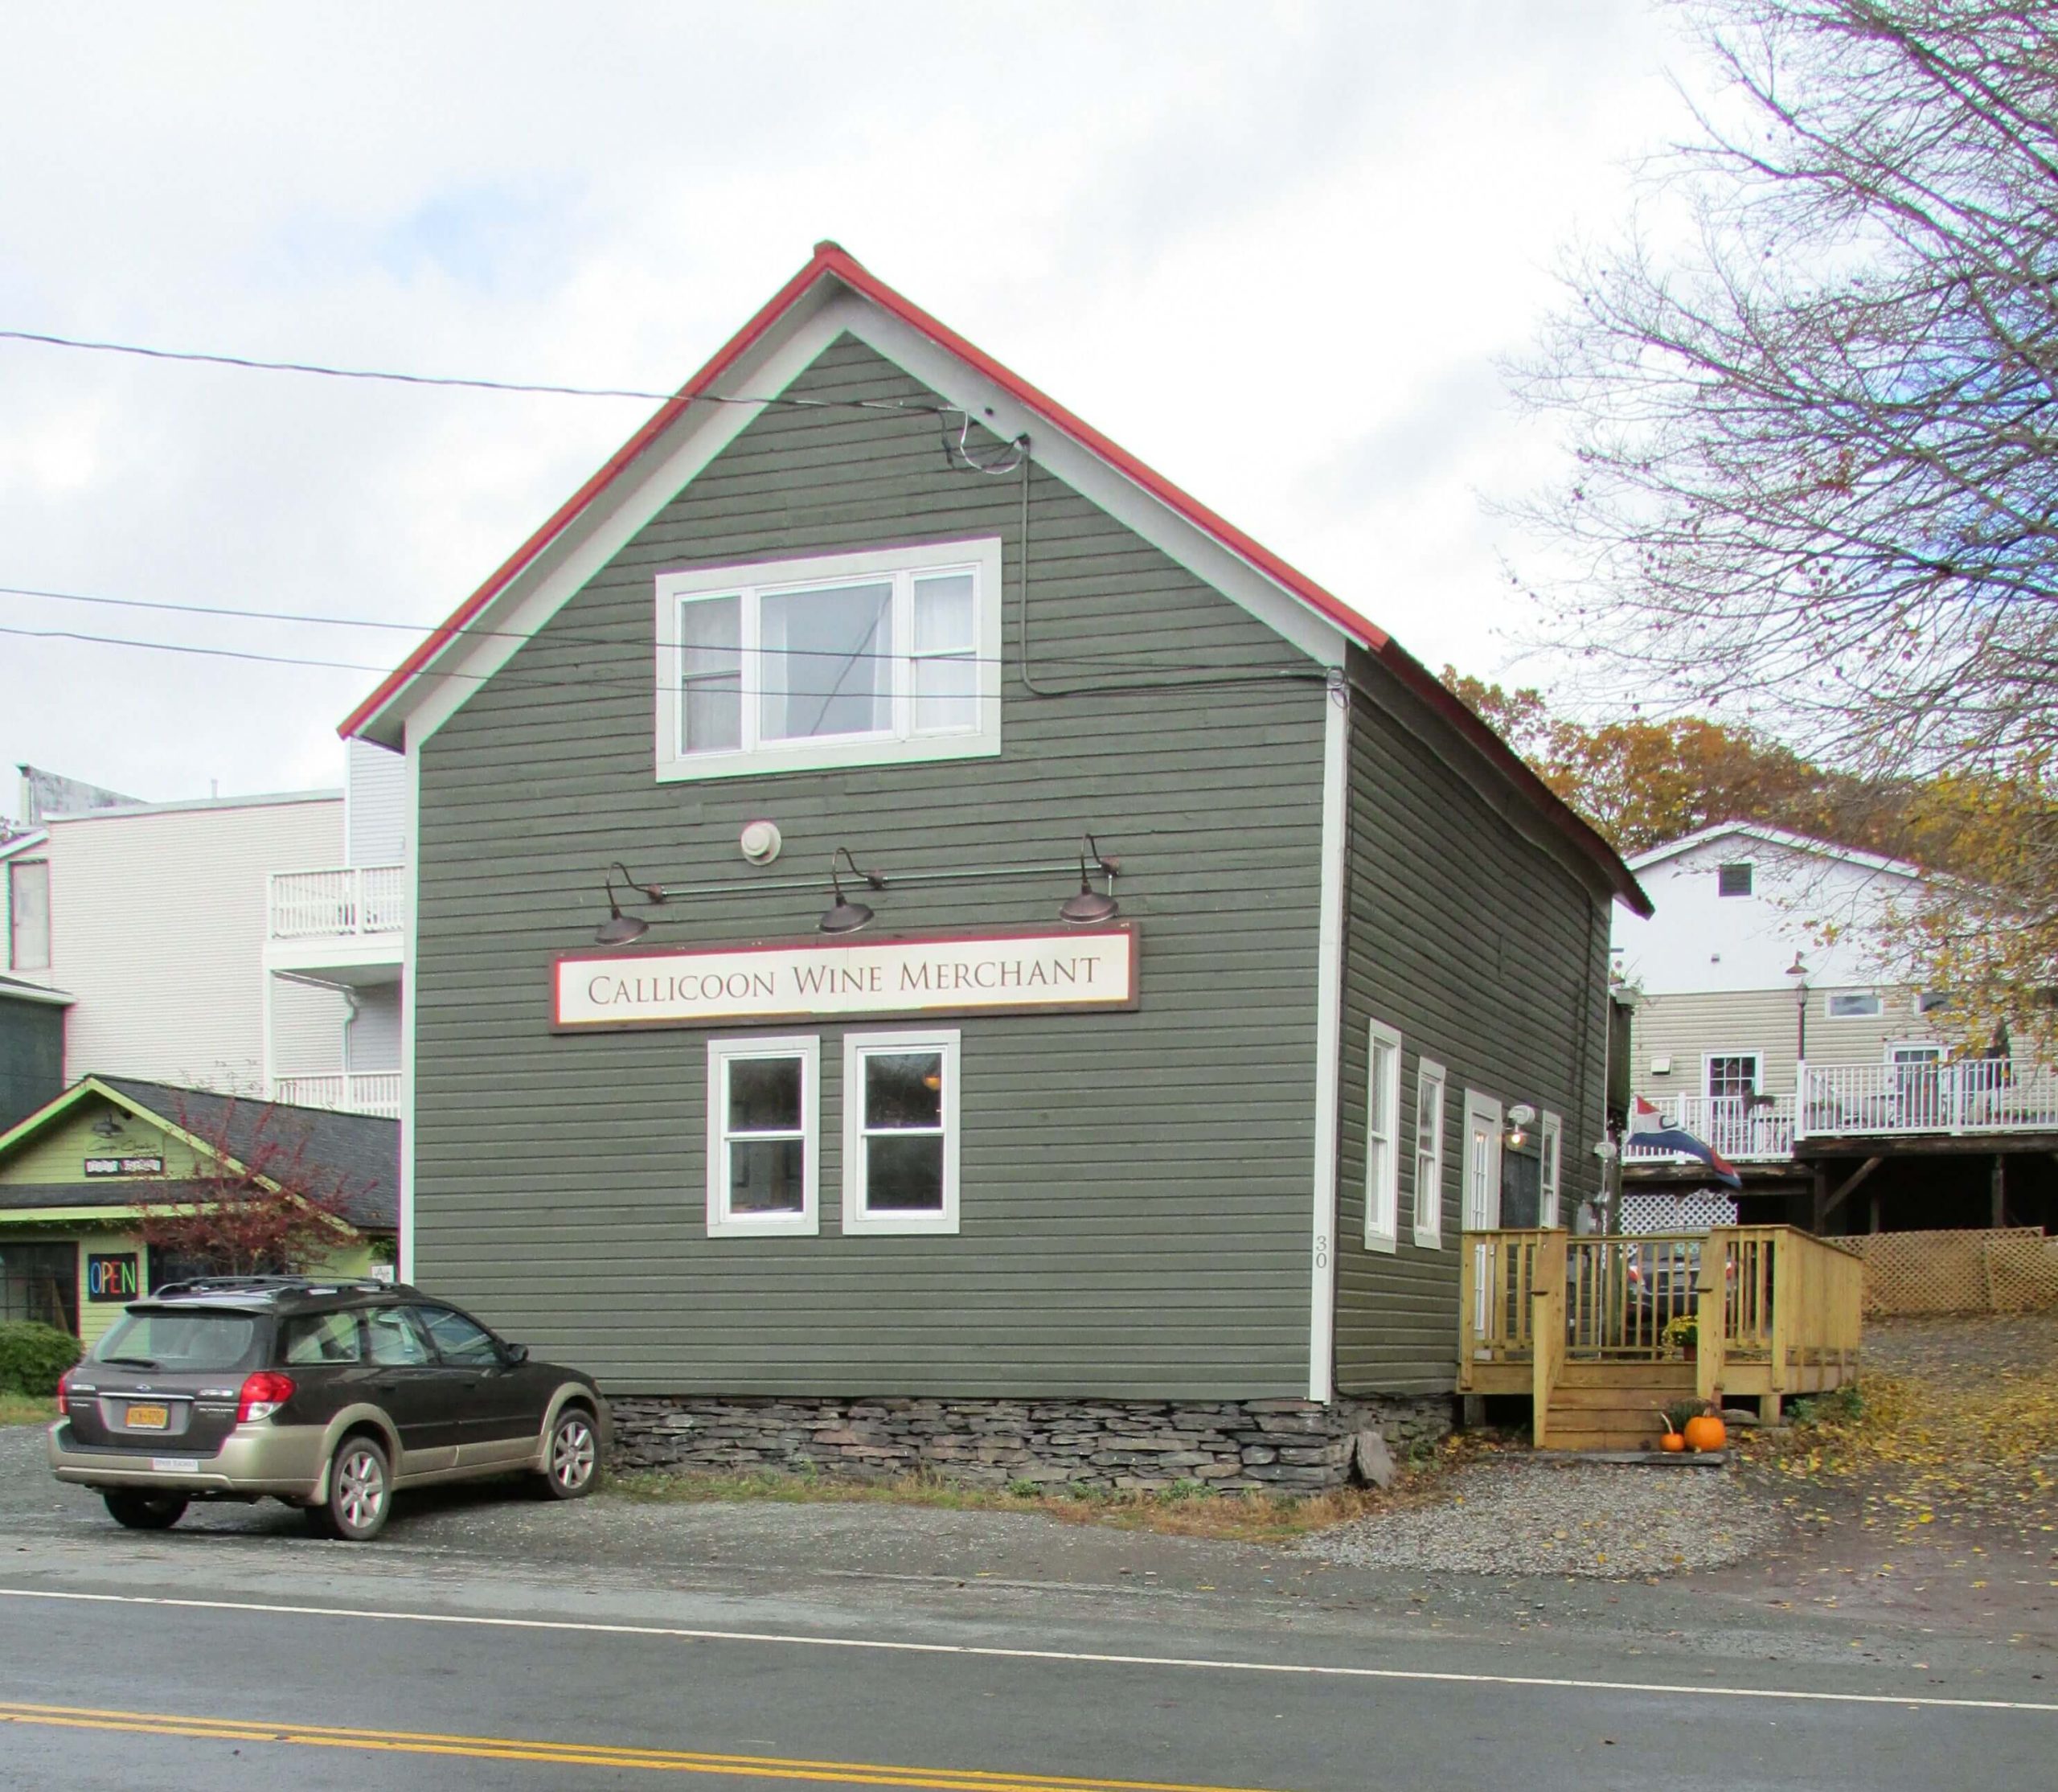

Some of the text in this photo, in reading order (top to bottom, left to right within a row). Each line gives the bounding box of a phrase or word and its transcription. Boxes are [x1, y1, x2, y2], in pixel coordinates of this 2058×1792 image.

[588, 957, 1101, 1005] CALLICOON WINE MERCHANT
[90, 1261, 136, 1294] OPEN
